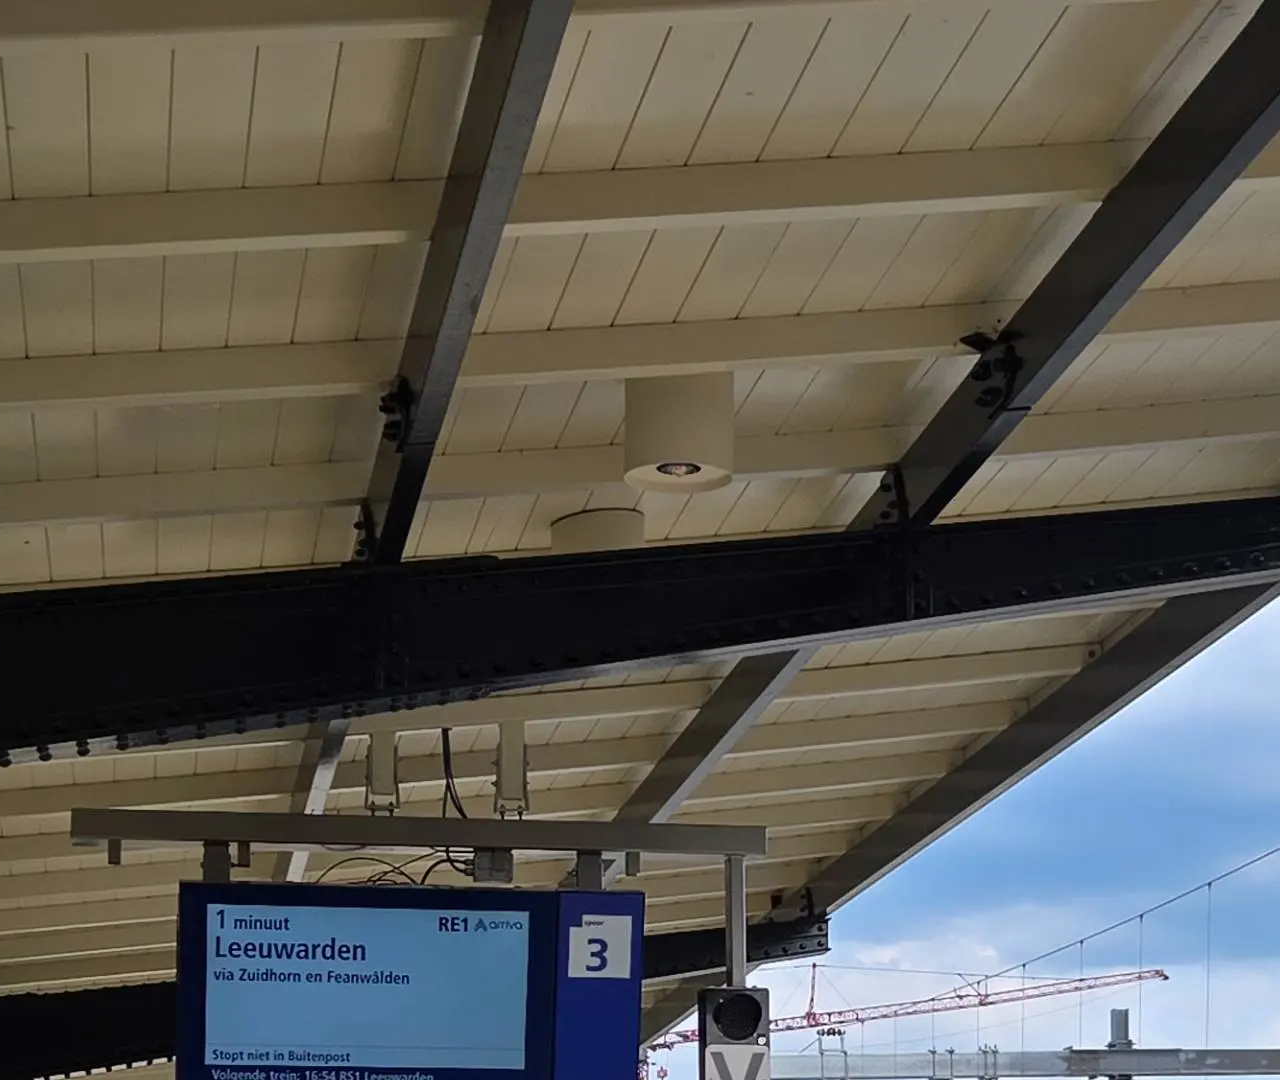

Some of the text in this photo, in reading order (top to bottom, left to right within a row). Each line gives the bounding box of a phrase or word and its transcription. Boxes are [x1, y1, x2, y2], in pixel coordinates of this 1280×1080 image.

[216, 909, 290, 931] 1 minuut
[438, 917, 468, 932] RE1
[215, 936, 366, 961] Leeuwarden
[585, 938, 609, 972] 3
[214, 968, 410, 985] via Zuidhorn en Feanwâlden
[212, 1049, 351, 1063] Stopt niet in Buitenpost
